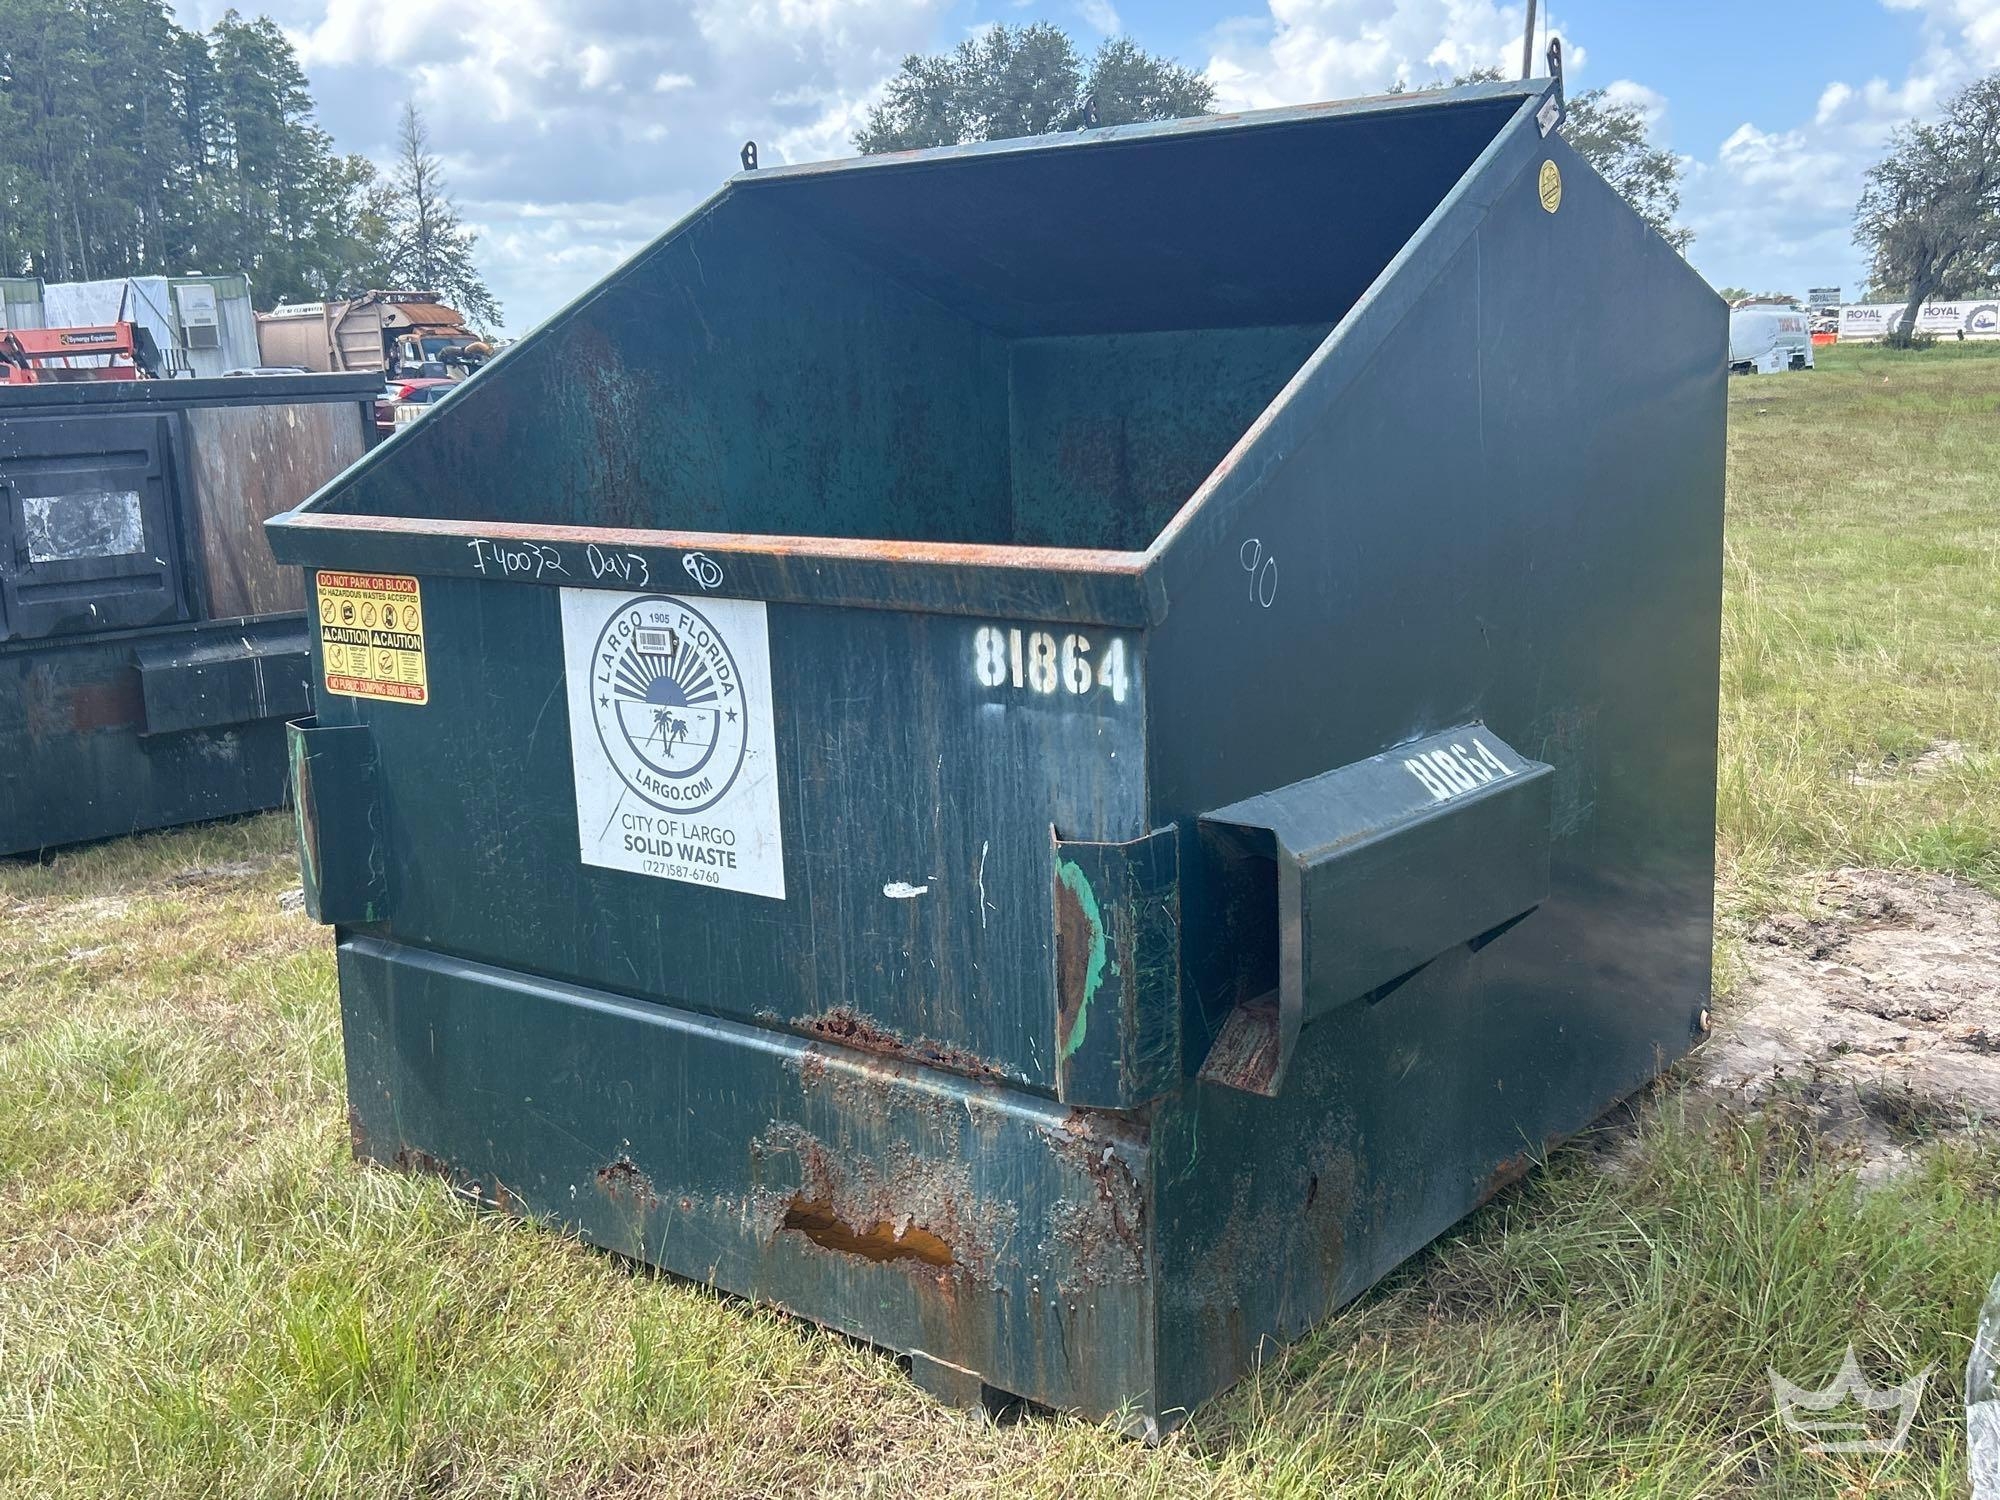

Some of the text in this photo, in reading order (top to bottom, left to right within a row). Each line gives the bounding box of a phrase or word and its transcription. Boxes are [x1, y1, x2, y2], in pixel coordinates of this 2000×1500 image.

[1846, 310, 1882, 319] ROYAL
[1923, 307, 1960, 316] ROYAL
[321, 574, 414, 592] DO NOT PARK OR BLOCK
[328, 589, 362, 599] HAZARDOUS
[363, 592, 386, 600] WASTES
[387, 594, 418, 603] ACCEPTED
[650, 613, 670, 624] 1905
[331, 627, 369, 645] CAUTION
[381, 632, 421, 650] CAUTION
[598, 611, 642, 684] LARGO
[679, 613, 735, 697] FLORIDA
[974, 626, 1130, 703] 81864
[635, 768, 713, 801] LARGO.COM
[622, 813, 736, 846] CITY OF LARGO
[624, 834, 737, 869] SOLID WASTE
[642, 860, 720, 884] (727)587-6760
